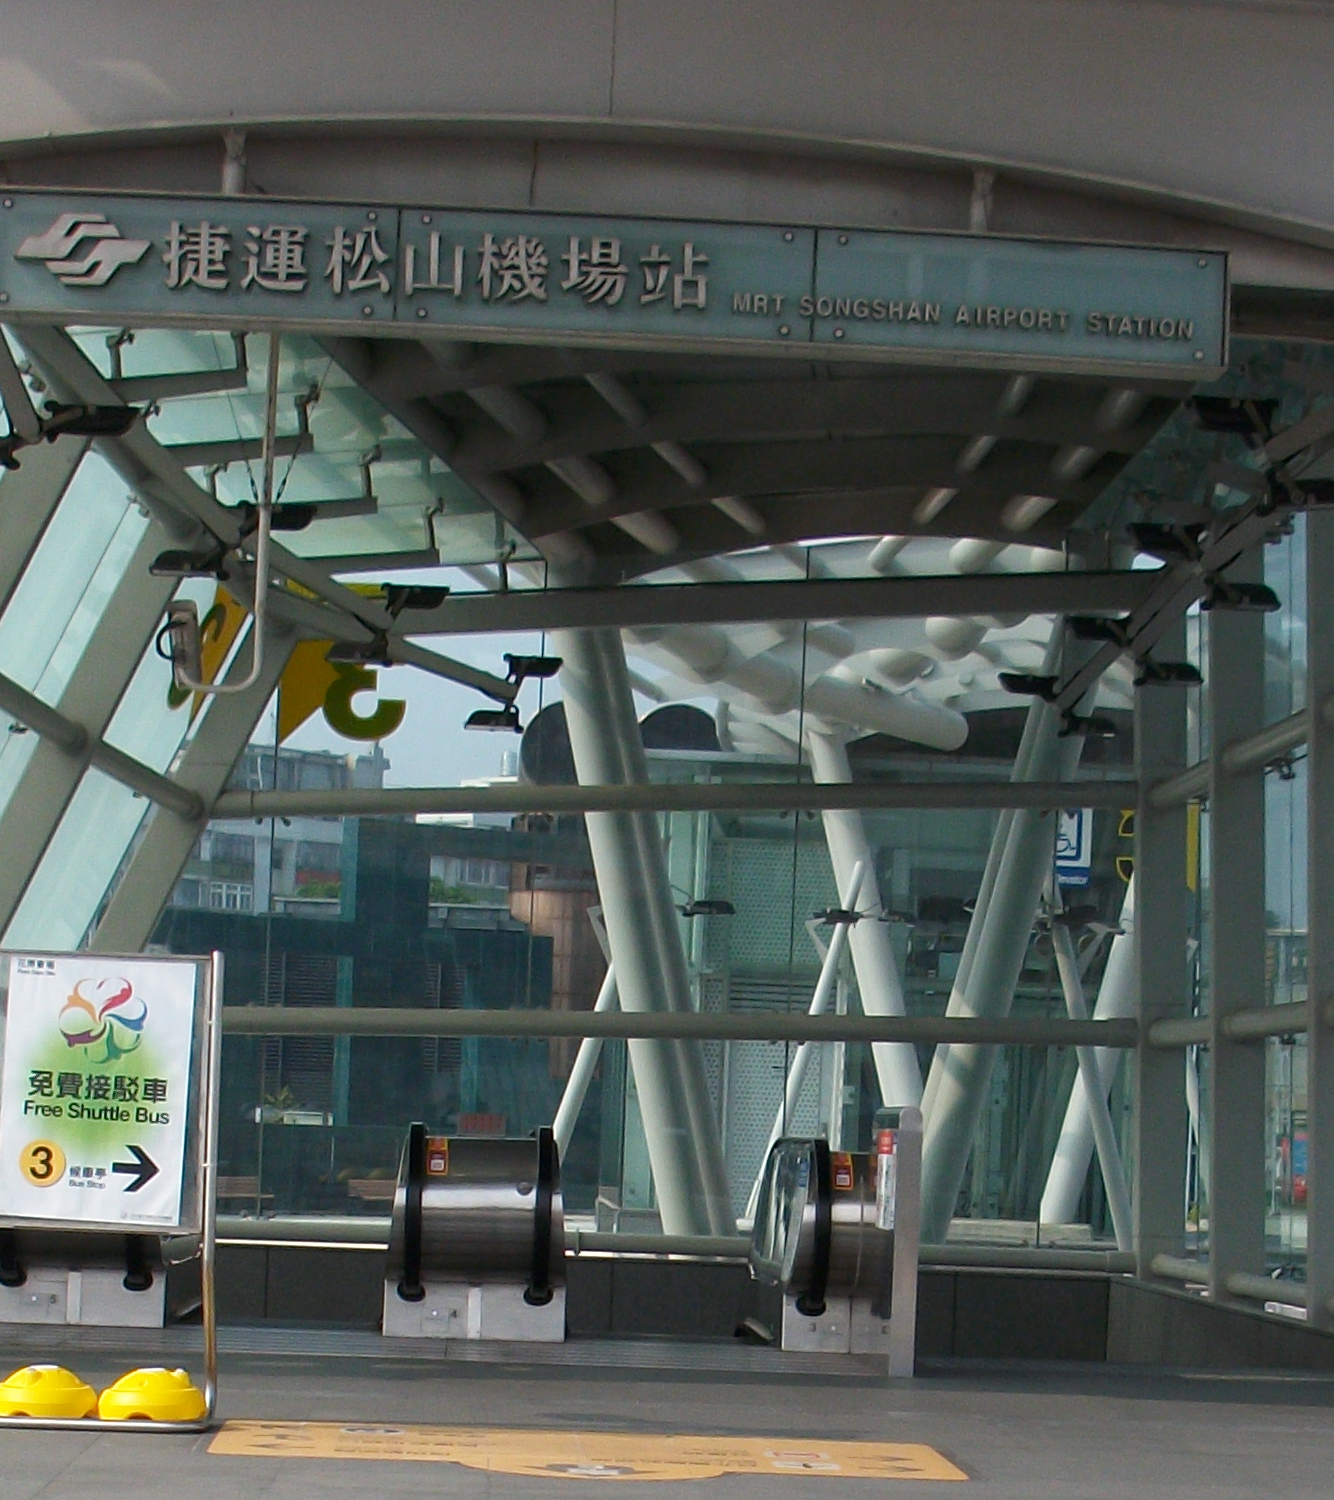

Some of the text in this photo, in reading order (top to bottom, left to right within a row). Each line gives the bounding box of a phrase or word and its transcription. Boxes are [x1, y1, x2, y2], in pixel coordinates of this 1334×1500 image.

[162, 220, 709, 310] 捷運松山機場站
[732, 291, 1194, 341] MRT SONGSHAN AIRPORT STATION
[28, 1070, 168, 1103] 免費接駁車
[23, 1099, 170, 1125] Free Shuttle Bus
[29, 1146, 54, 1179] 3
